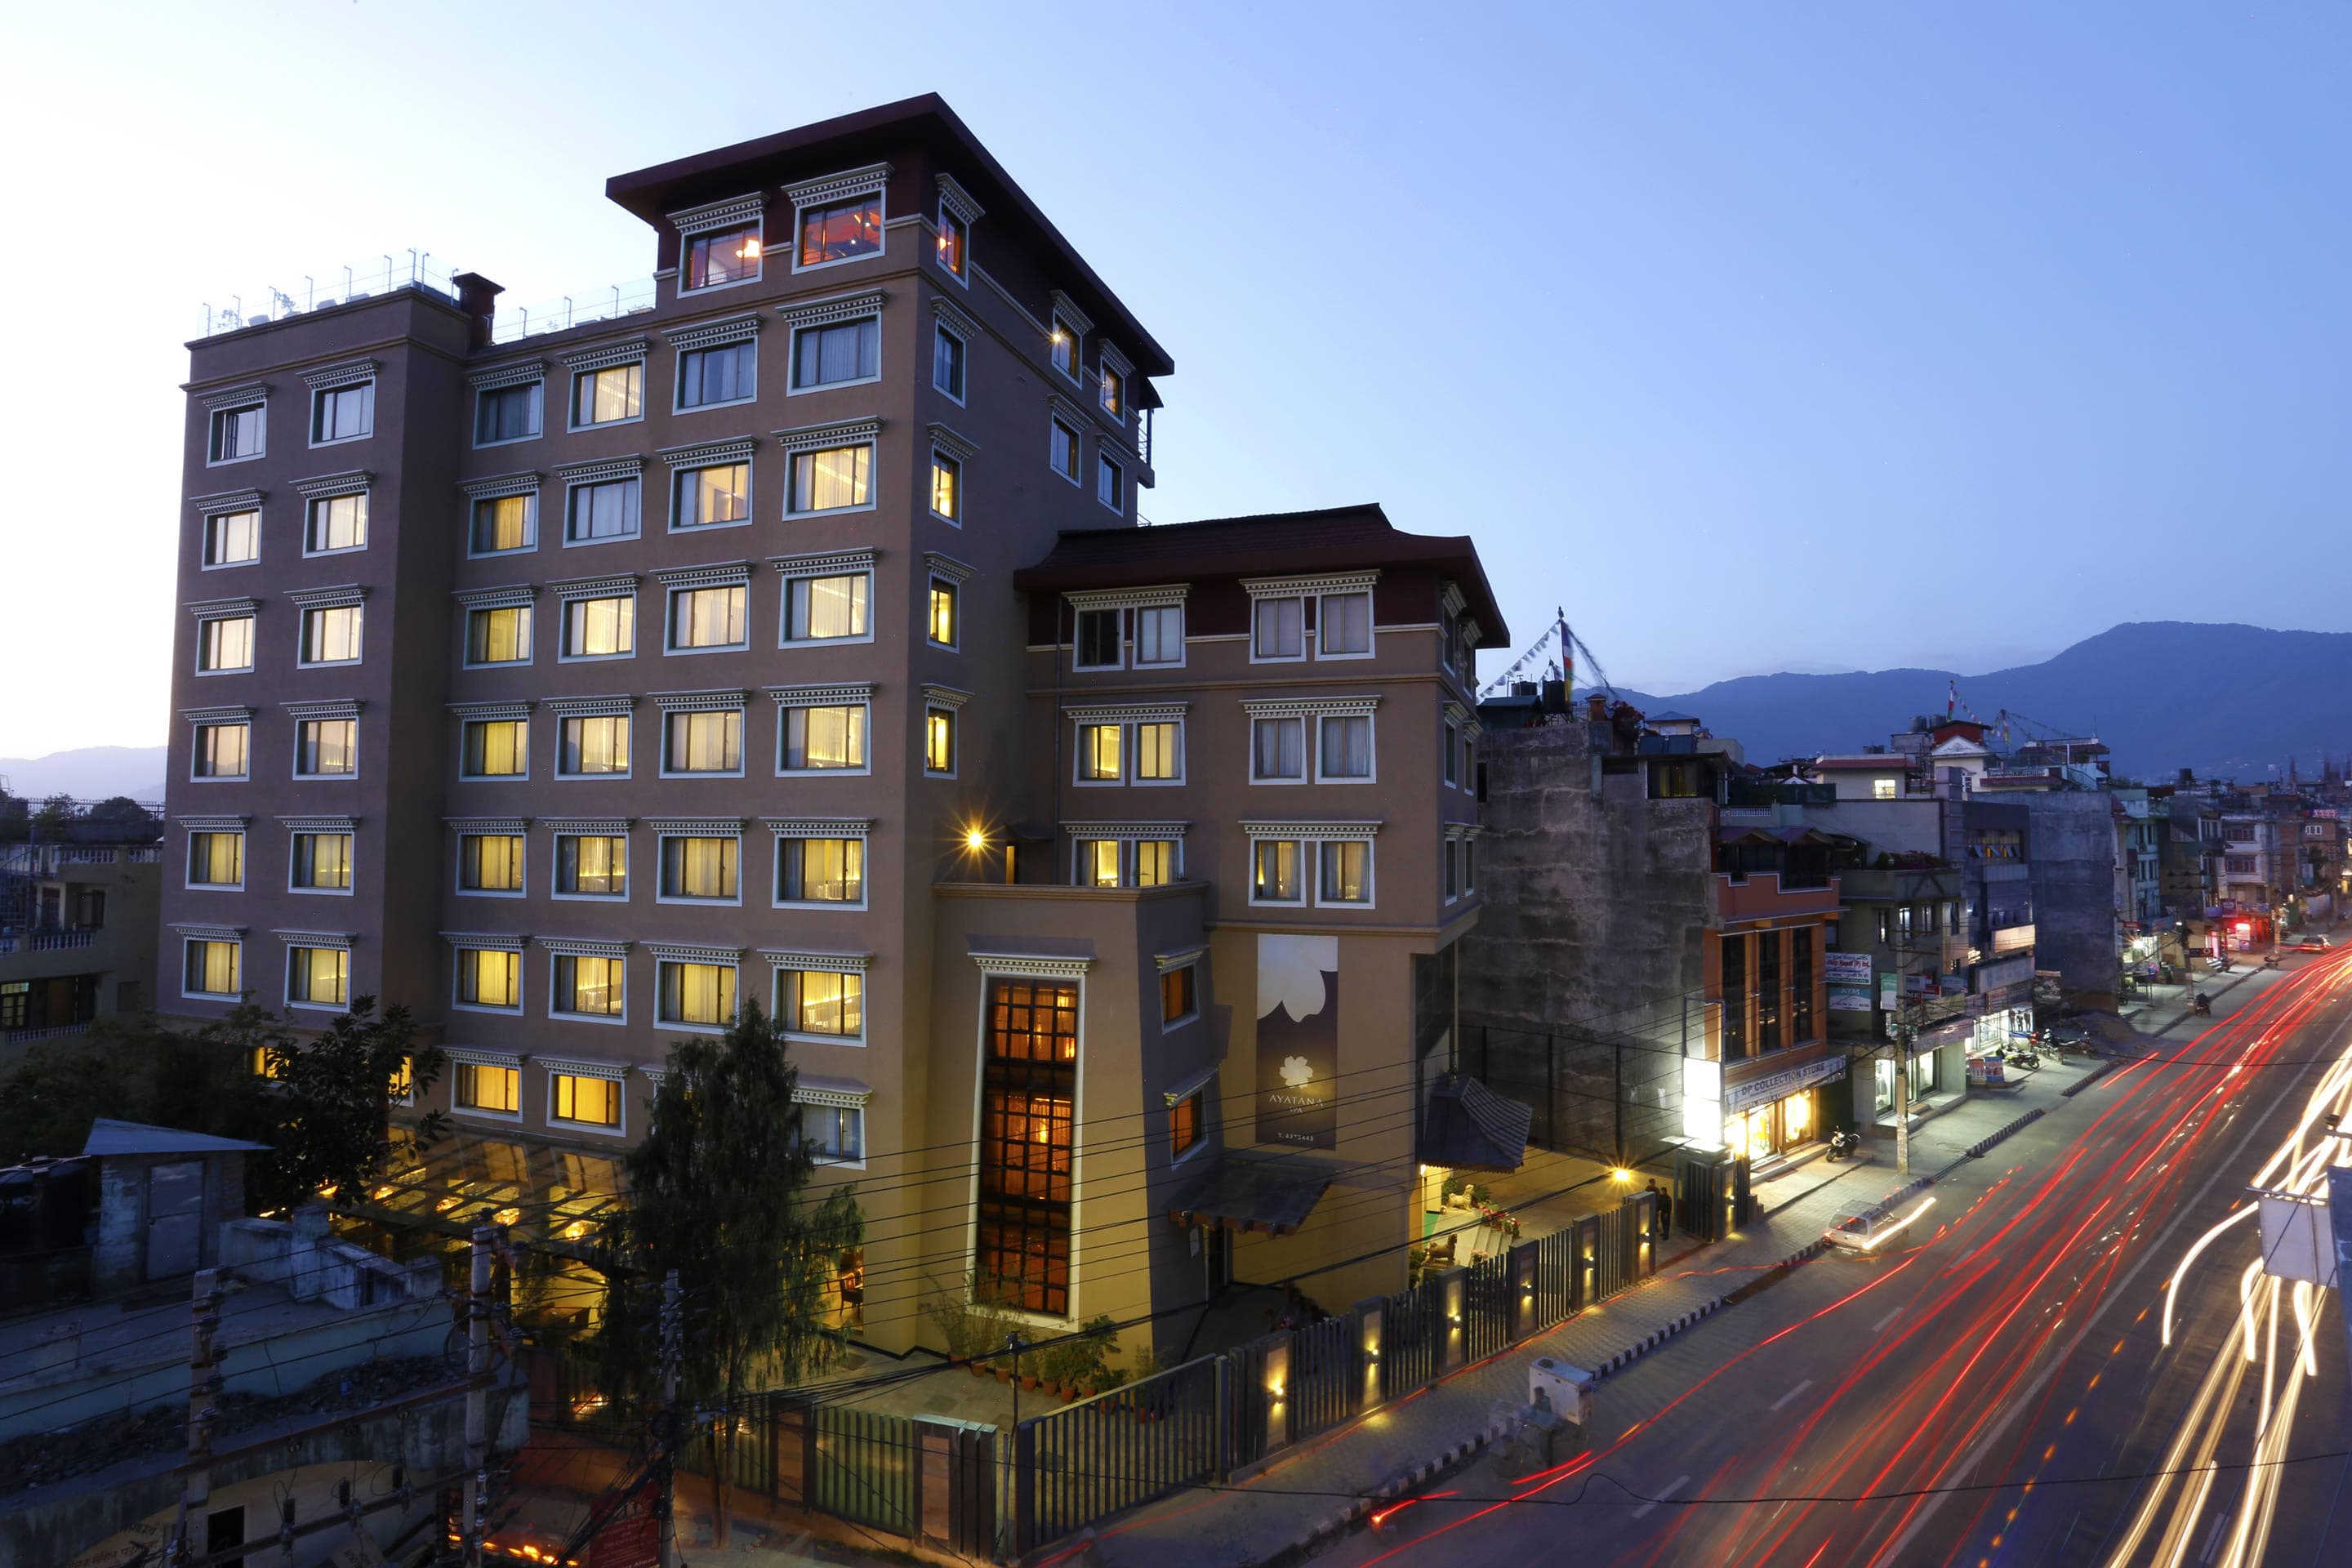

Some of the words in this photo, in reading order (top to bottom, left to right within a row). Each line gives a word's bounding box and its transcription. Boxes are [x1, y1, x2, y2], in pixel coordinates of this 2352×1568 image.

[1754, 1071, 1802, 1091] COLLECTION
[1802, 1062, 1825, 1077] STORE
[1269, 1094, 1324, 1108] AYATANA
